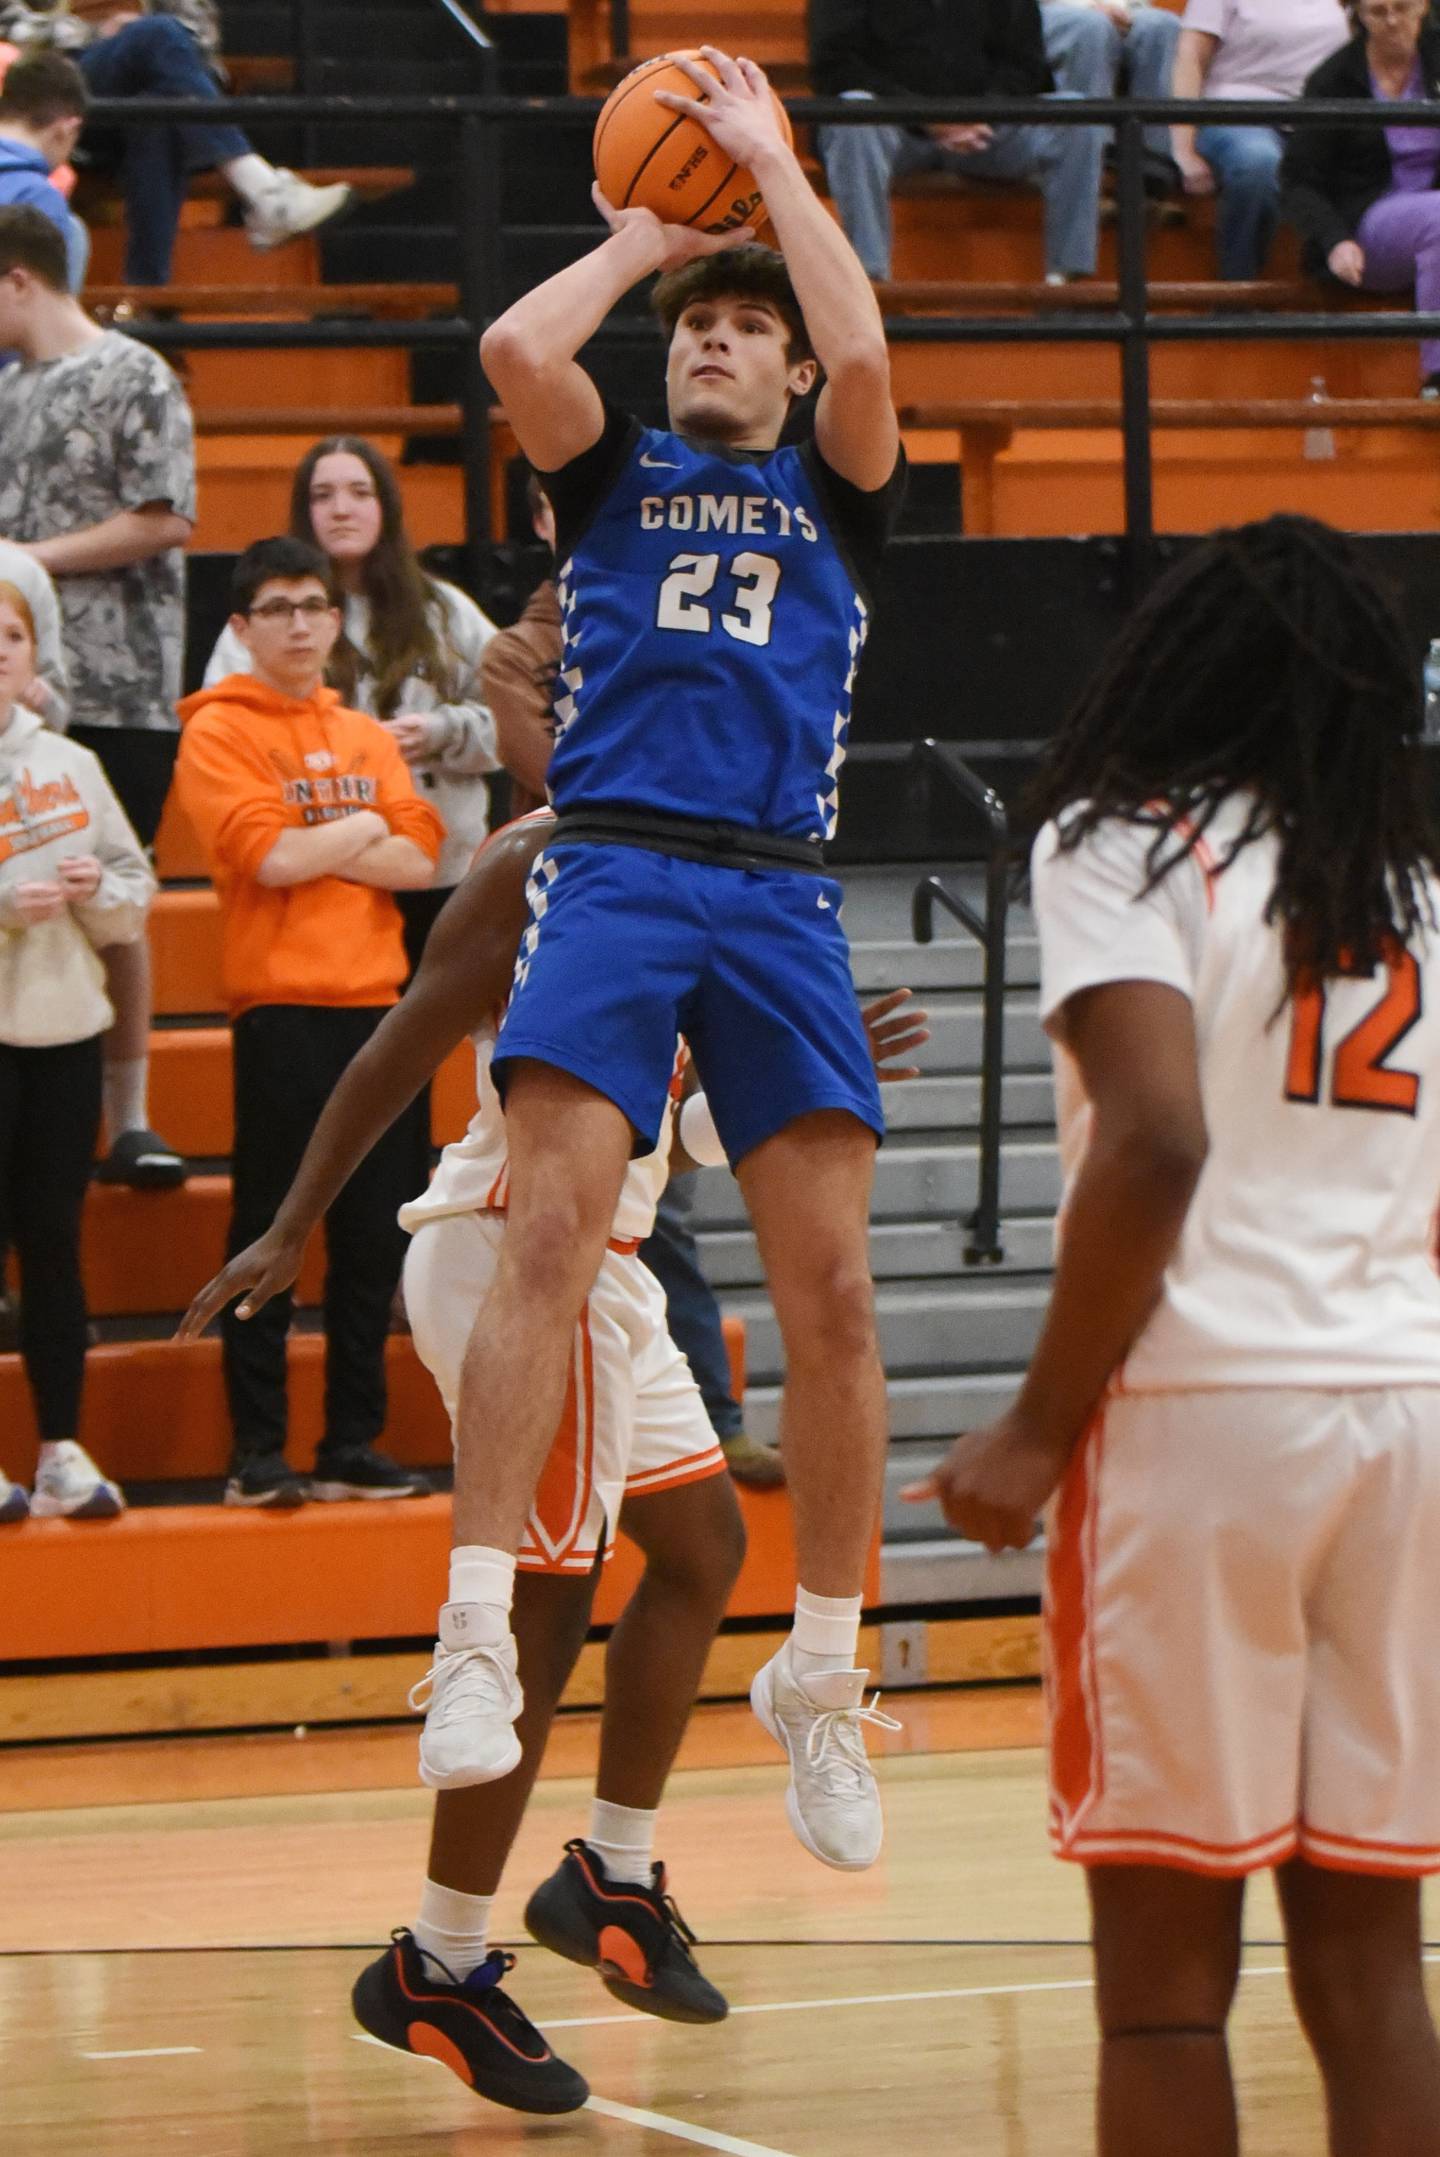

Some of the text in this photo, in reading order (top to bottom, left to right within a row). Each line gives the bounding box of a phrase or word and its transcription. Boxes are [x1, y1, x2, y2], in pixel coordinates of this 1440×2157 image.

[640, 495, 818, 542] COMETS
[657, 552, 781, 646] 23
[1284, 930, 1422, 1116] 12
